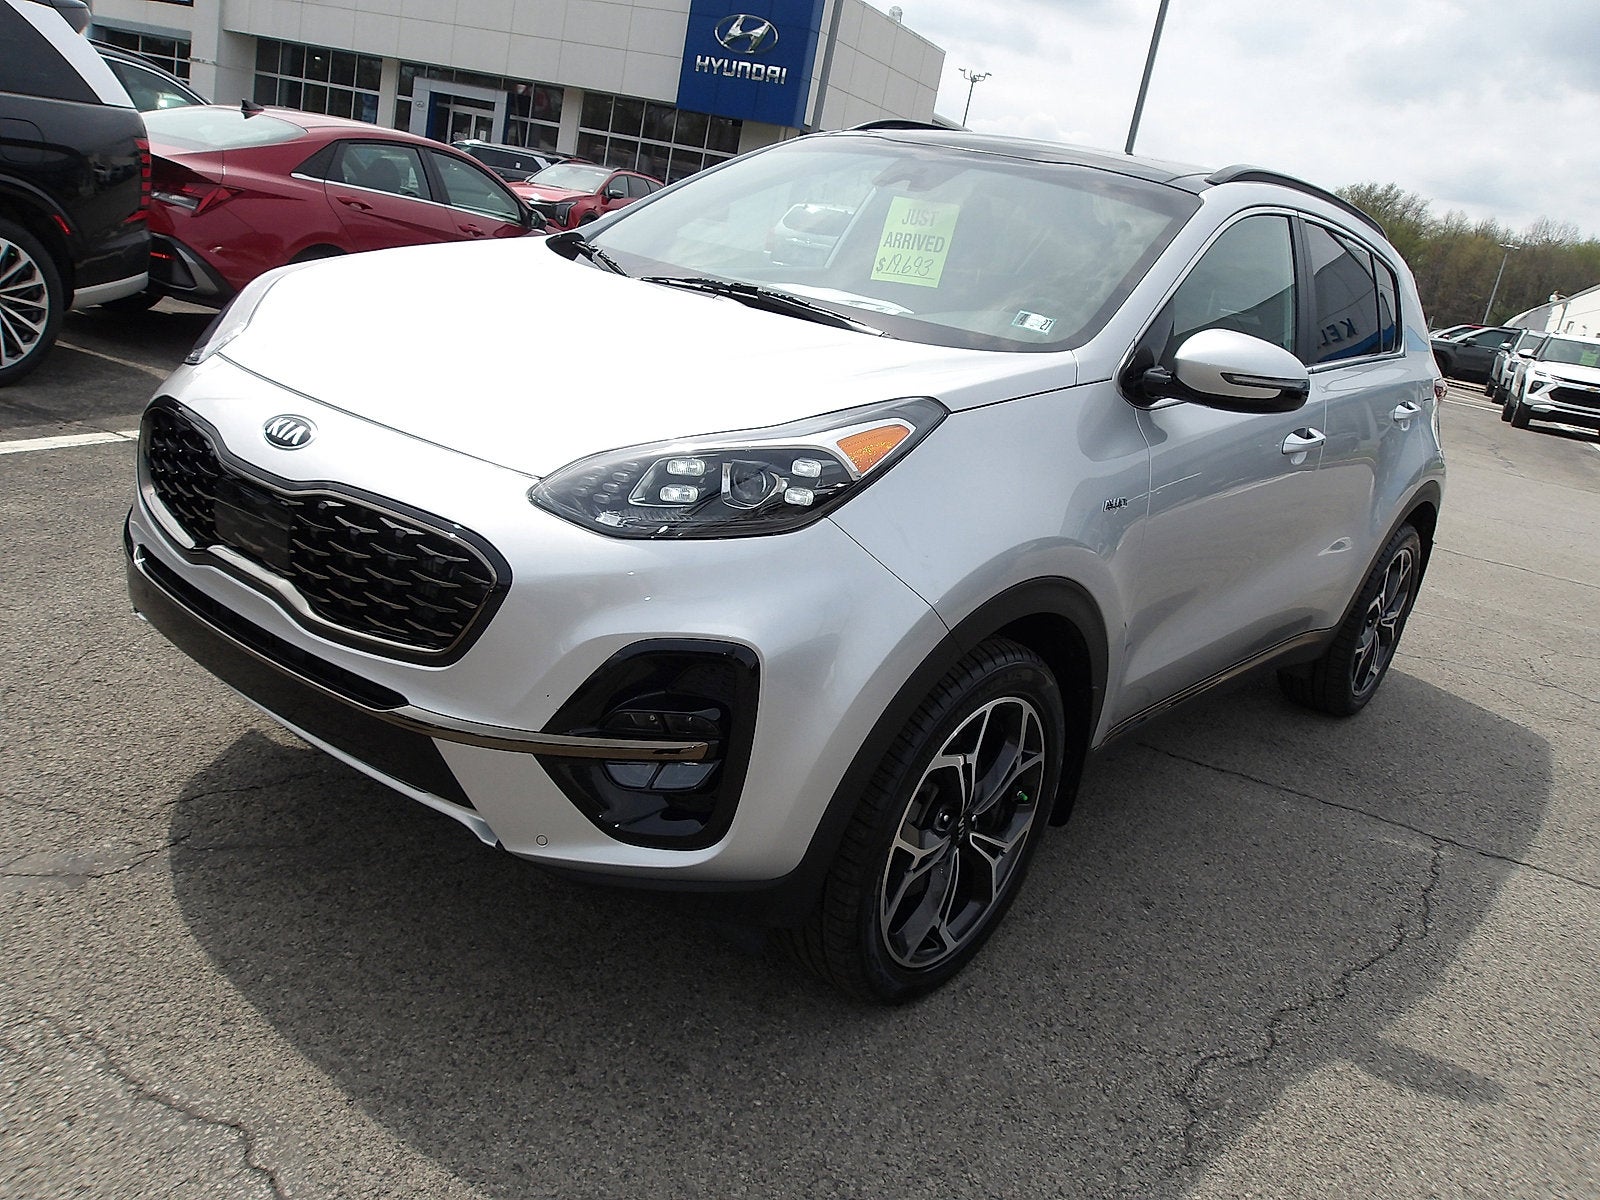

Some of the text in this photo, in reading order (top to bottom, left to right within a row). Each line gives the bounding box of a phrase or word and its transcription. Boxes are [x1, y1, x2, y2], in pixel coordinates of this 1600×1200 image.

[695, 54, 787, 85] HYUNDAI
[902, 208, 940, 227] JUST
[883, 231, 946, 253] ARRIVED
[1039, 318, 1053, 331] 27
[266, 417, 307, 446] KIA
